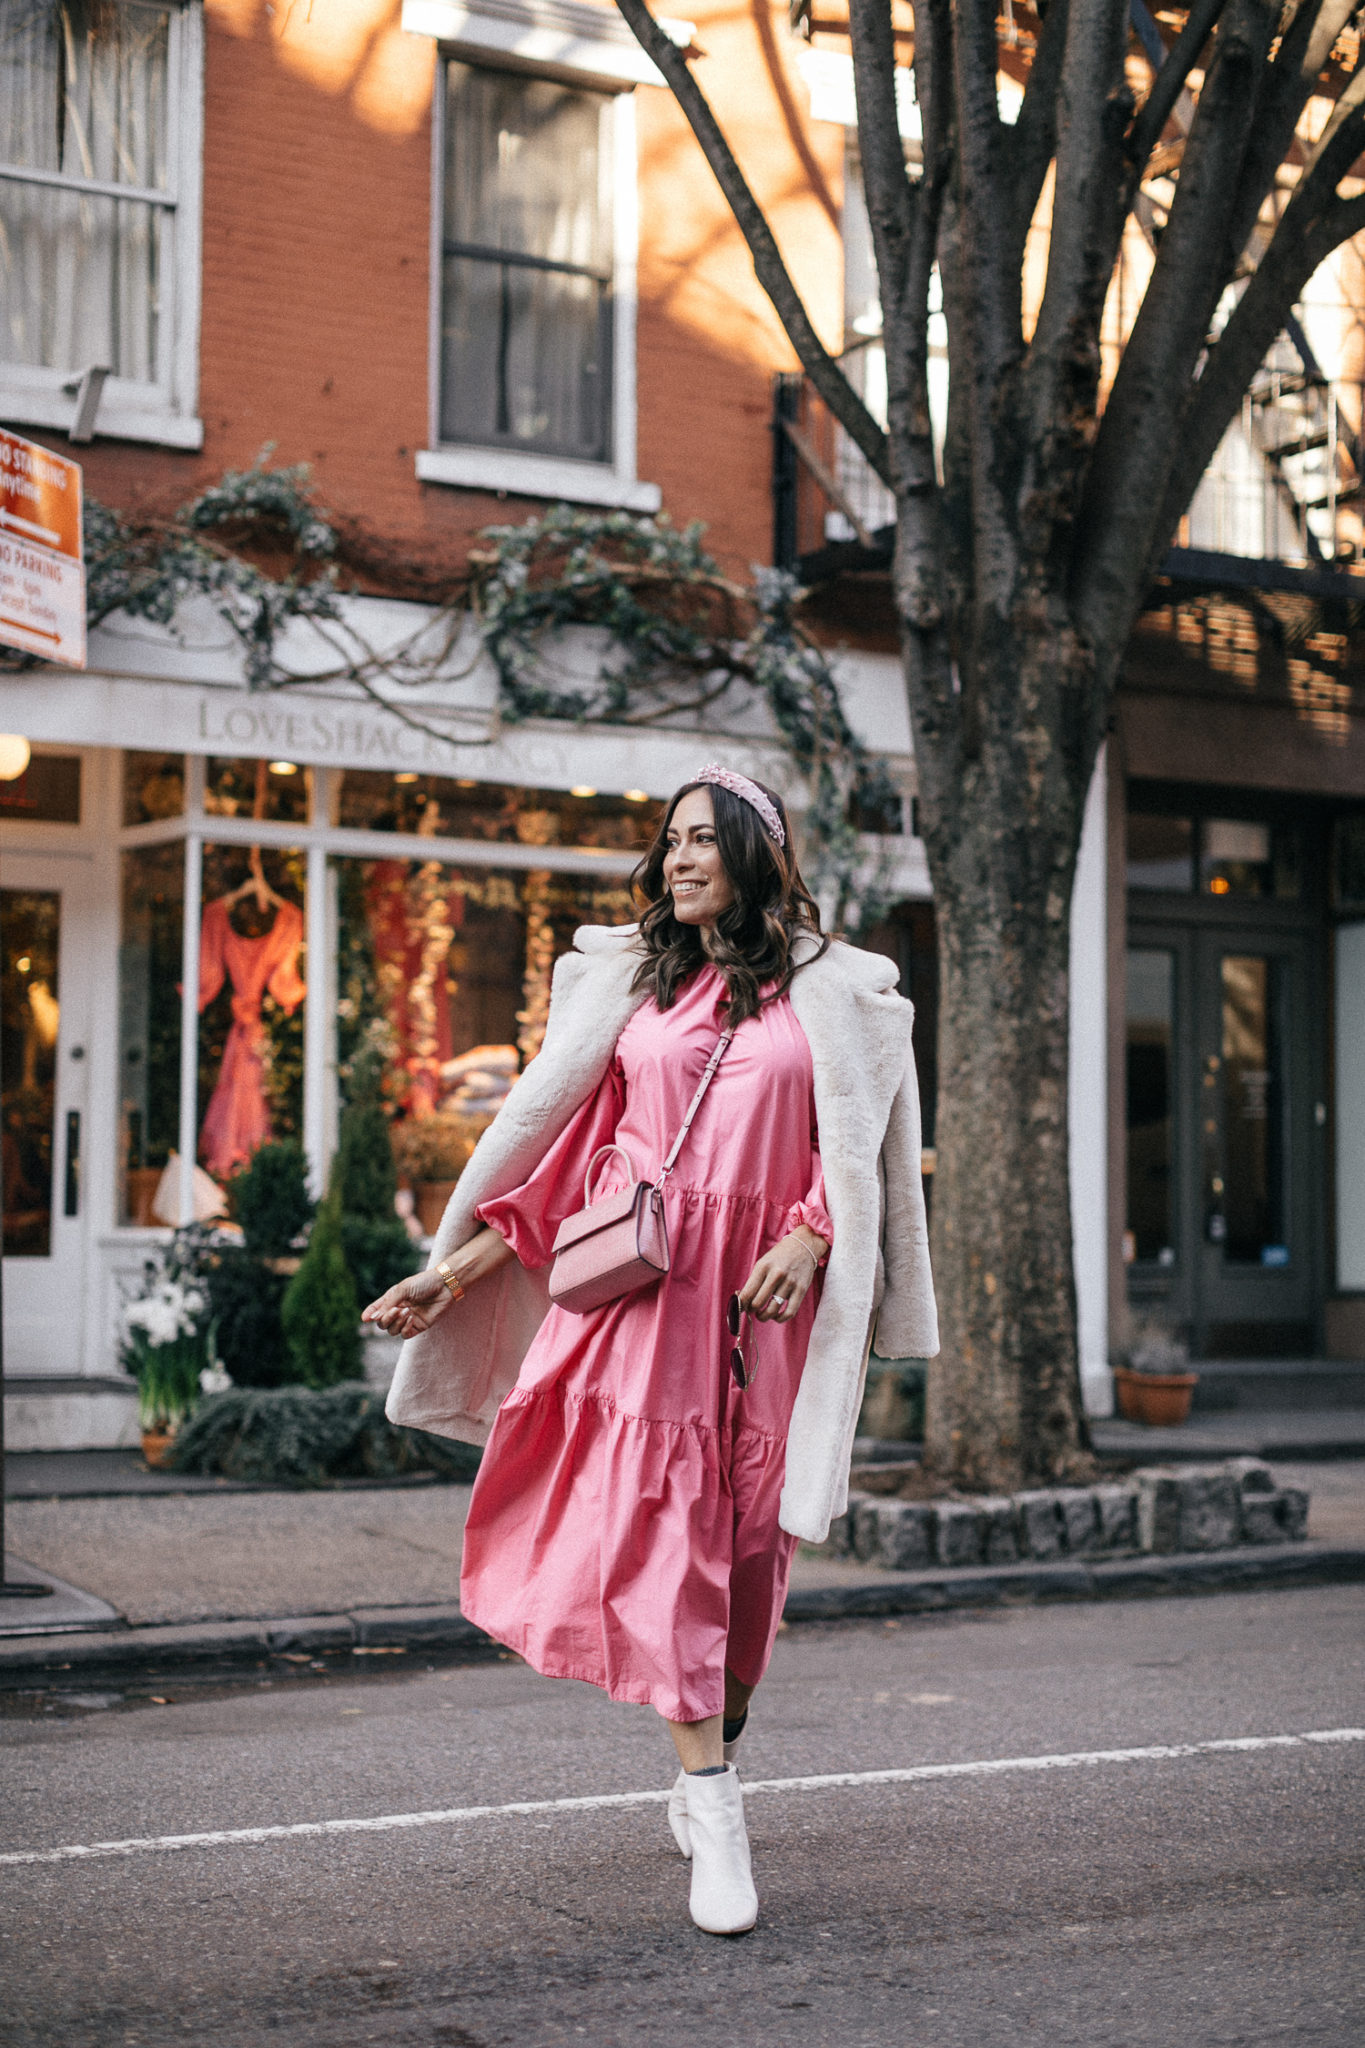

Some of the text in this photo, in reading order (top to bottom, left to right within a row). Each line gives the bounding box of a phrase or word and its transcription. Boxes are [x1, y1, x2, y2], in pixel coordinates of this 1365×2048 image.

[0, 444, 67, 491] O STANDING
[15, 549, 62, 583] PARKING
